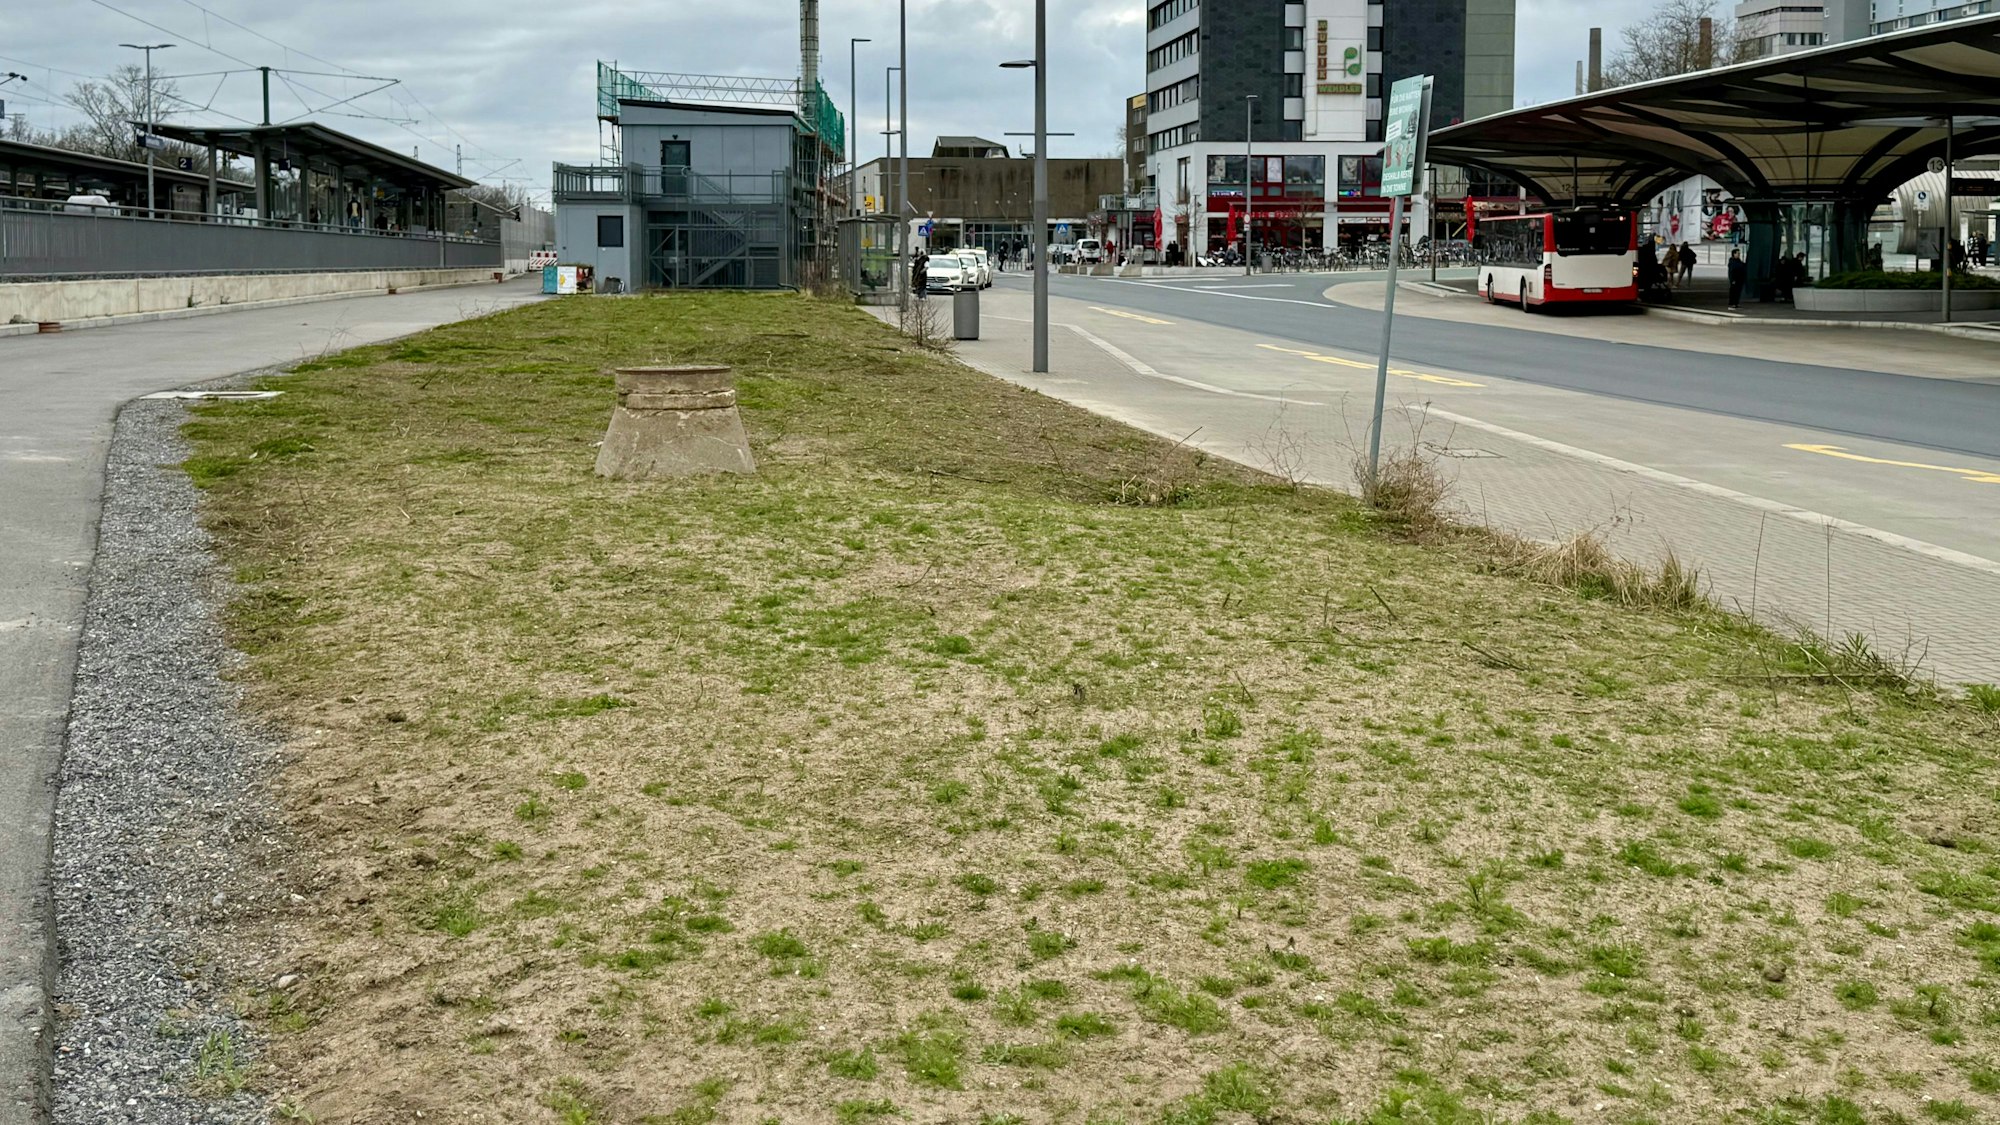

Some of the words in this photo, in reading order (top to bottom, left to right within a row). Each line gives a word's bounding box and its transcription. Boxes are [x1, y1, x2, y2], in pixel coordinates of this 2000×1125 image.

[1318, 20, 1327, 80] MUSIK
[1318, 85, 1360, 93] WENDLER
[180, 158, 187, 168] 2
[286, 160, 291, 168] 1
[1930, 160, 1944, 171] 13
